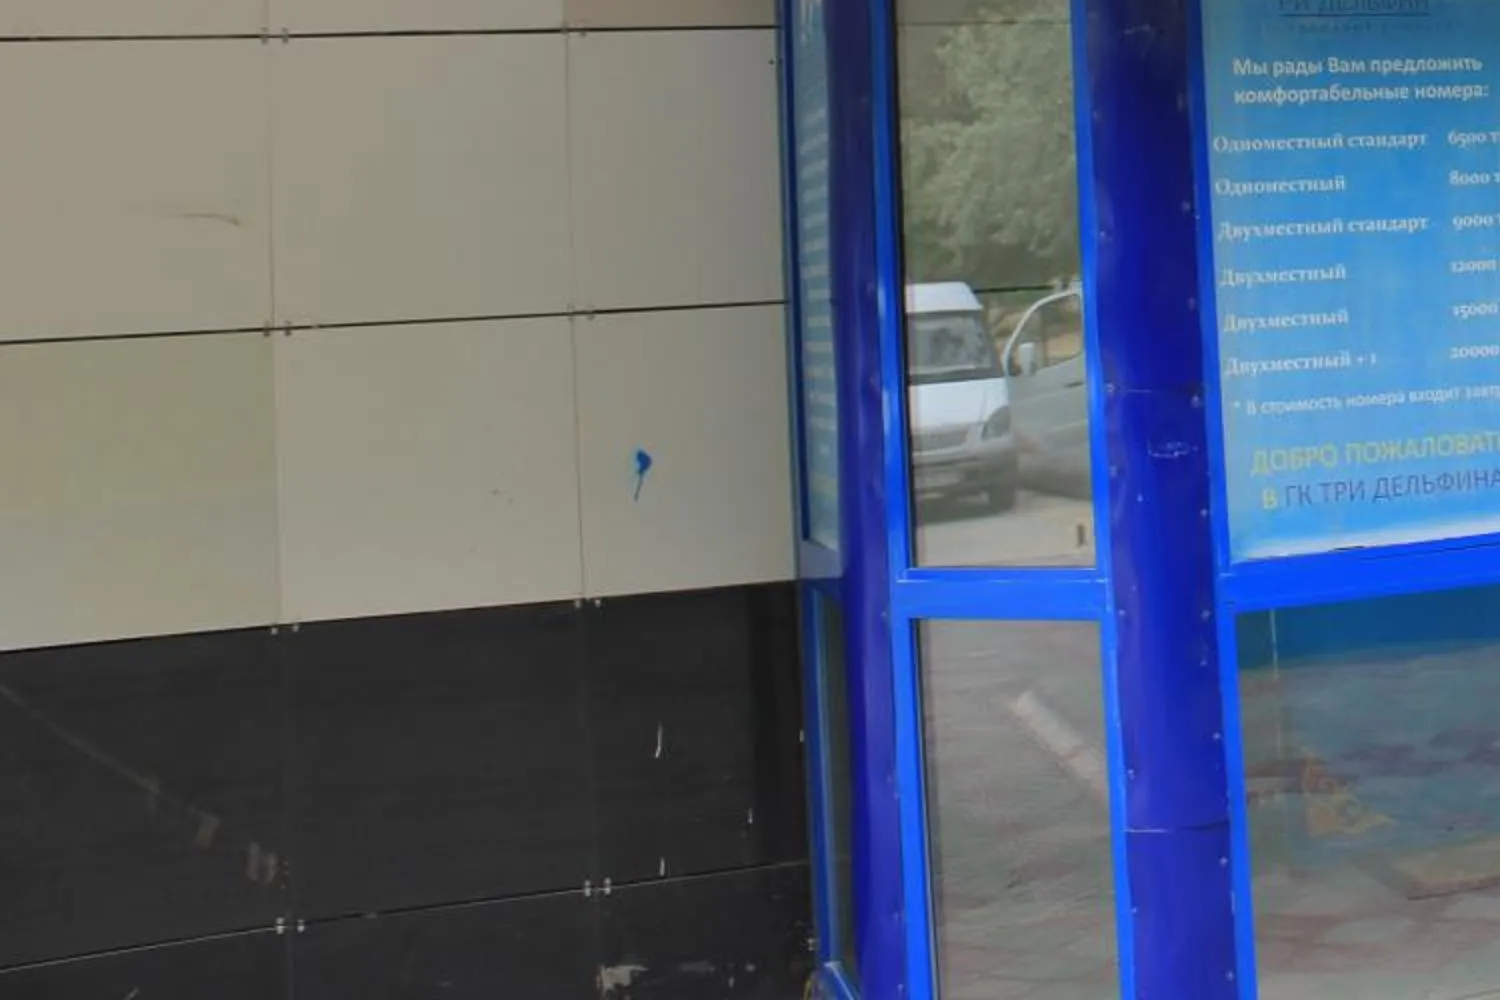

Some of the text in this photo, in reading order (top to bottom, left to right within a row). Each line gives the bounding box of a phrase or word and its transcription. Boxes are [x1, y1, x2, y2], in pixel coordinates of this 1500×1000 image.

[1232, 56, 1483, 78] Мы рады Вам предложить
[1235, 82, 1489, 106] комфортабельные номера:
[1213, 132, 1343, 154] Одноместный
[1347, 132, 1429, 150] стандарт
[1215, 174, 1346, 197] Одноместный
[1449, 169, 1490, 186] 8000
[1218, 216, 1343, 242] Двухместный
[1347, 215, 1429, 234] стандарт
[1452, 214, 1494, 232] 9000
[1219, 265, 1347, 289] Двухместный
[1223, 308, 1349, 333] Двухместный
[1224, 351, 1351, 377] Двухместный
[1261, 396, 1342, 414] стоимость
[1250, 444, 1338, 475] ДОБРО
[1285, 484, 1312, 507] ГК
[1319, 480, 1366, 505] ТРИ
